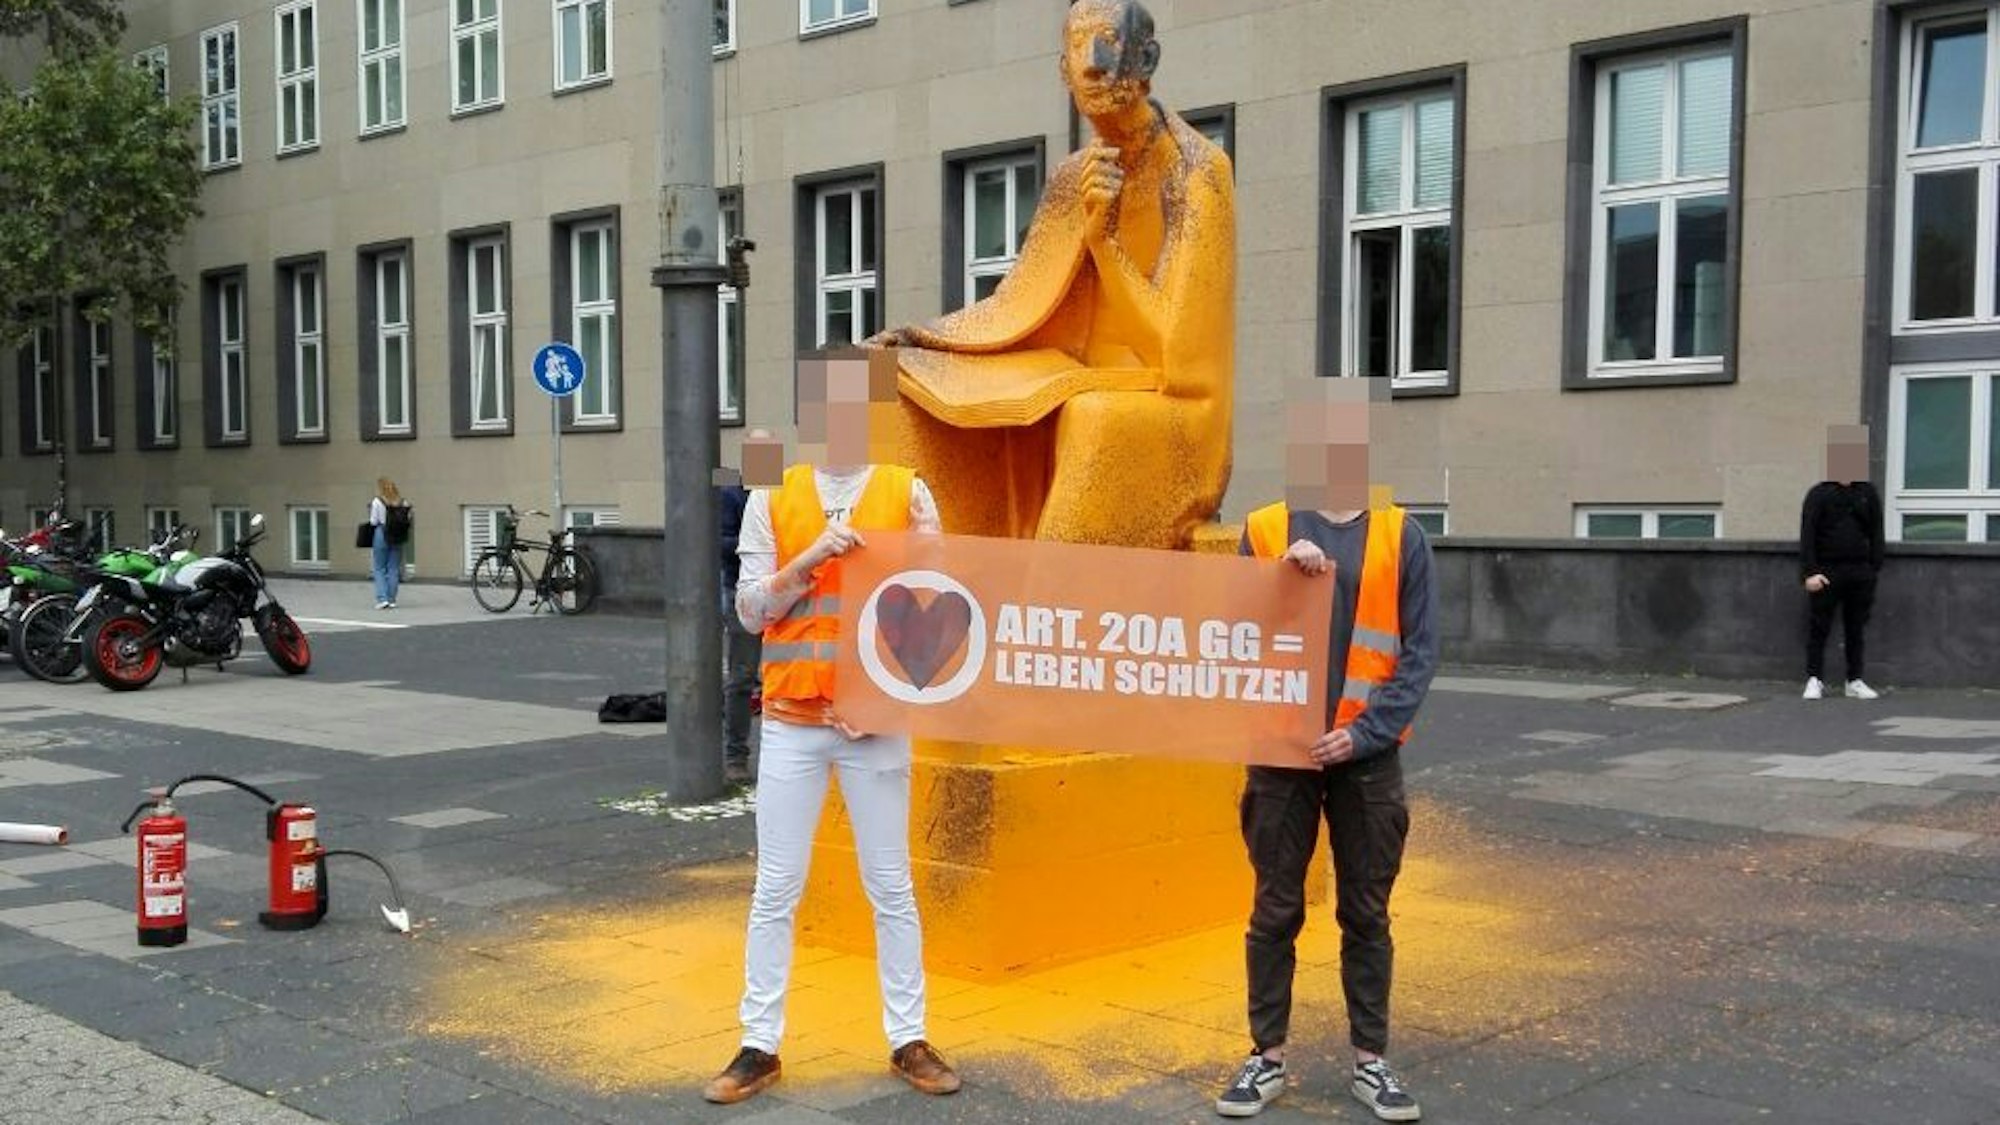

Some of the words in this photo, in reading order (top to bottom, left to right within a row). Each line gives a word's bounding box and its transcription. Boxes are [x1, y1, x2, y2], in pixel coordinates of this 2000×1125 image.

[994, 603, 1087, 650] ART.
[1097, 611, 1188, 658] 20A
[1198, 619, 1261, 662] GG
[1273, 634, 1303, 652] =
[994, 649, 1105, 691] LEBEN
[1114, 659, 1308, 705] SCHÜTZEN
